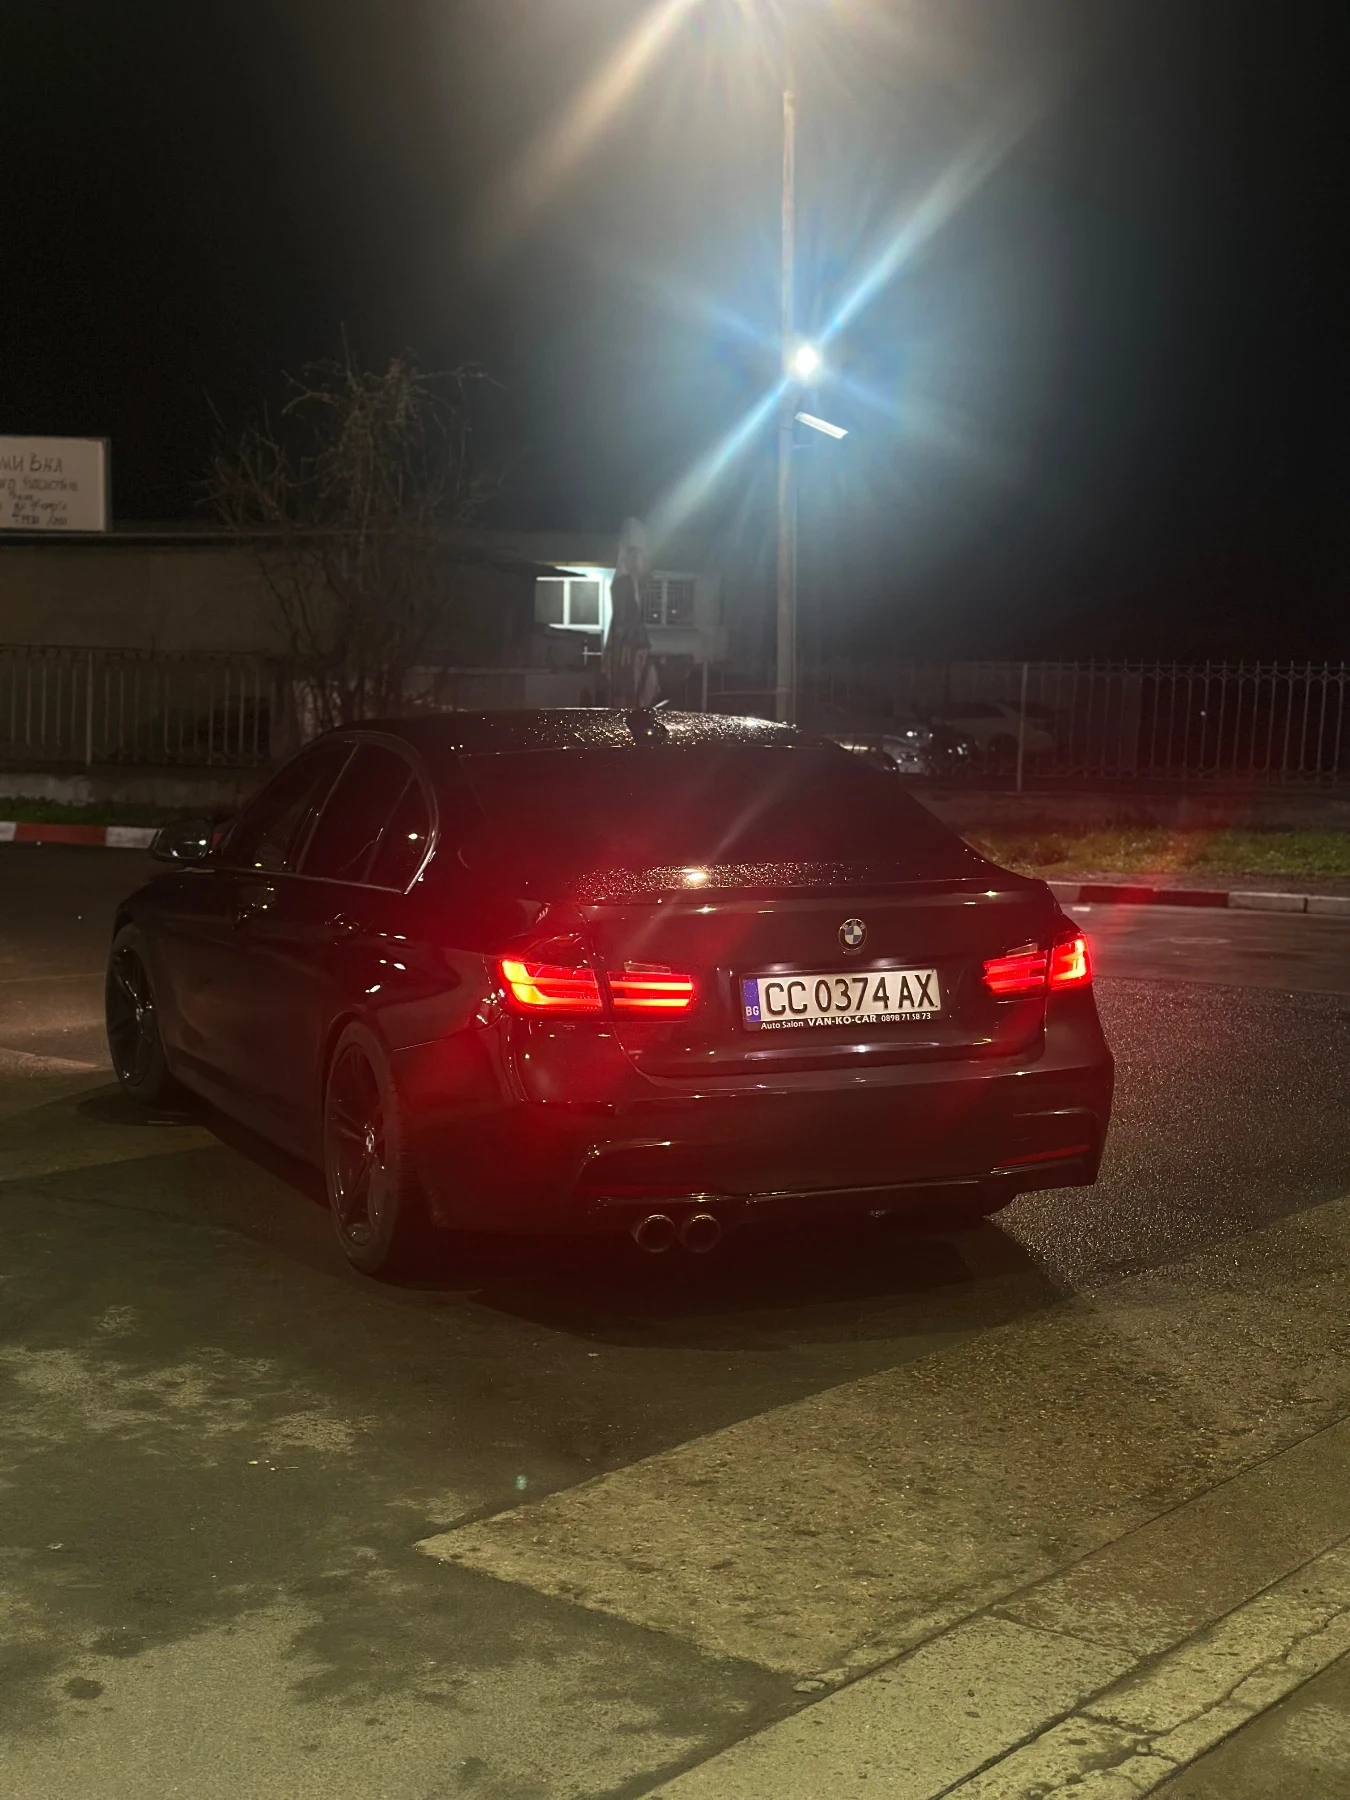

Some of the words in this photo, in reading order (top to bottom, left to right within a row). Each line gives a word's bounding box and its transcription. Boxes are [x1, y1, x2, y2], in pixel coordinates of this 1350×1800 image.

[764, 980, 808, 1016] CC
[814, 976, 890, 1013] 0374
[898, 973, 935, 1009] AX
[745, 1005, 759, 1017] BG
[760, 1022, 781, 1030] Auto
[782, 1020, 804, 1029] Salon
[807, 1014, 877, 1027] VAN-KO-CAR
[881, 1014, 900, 1022] 0898
[901, 1013, 910, 1021] 71
[921, 1012, 931, 1020] 73
